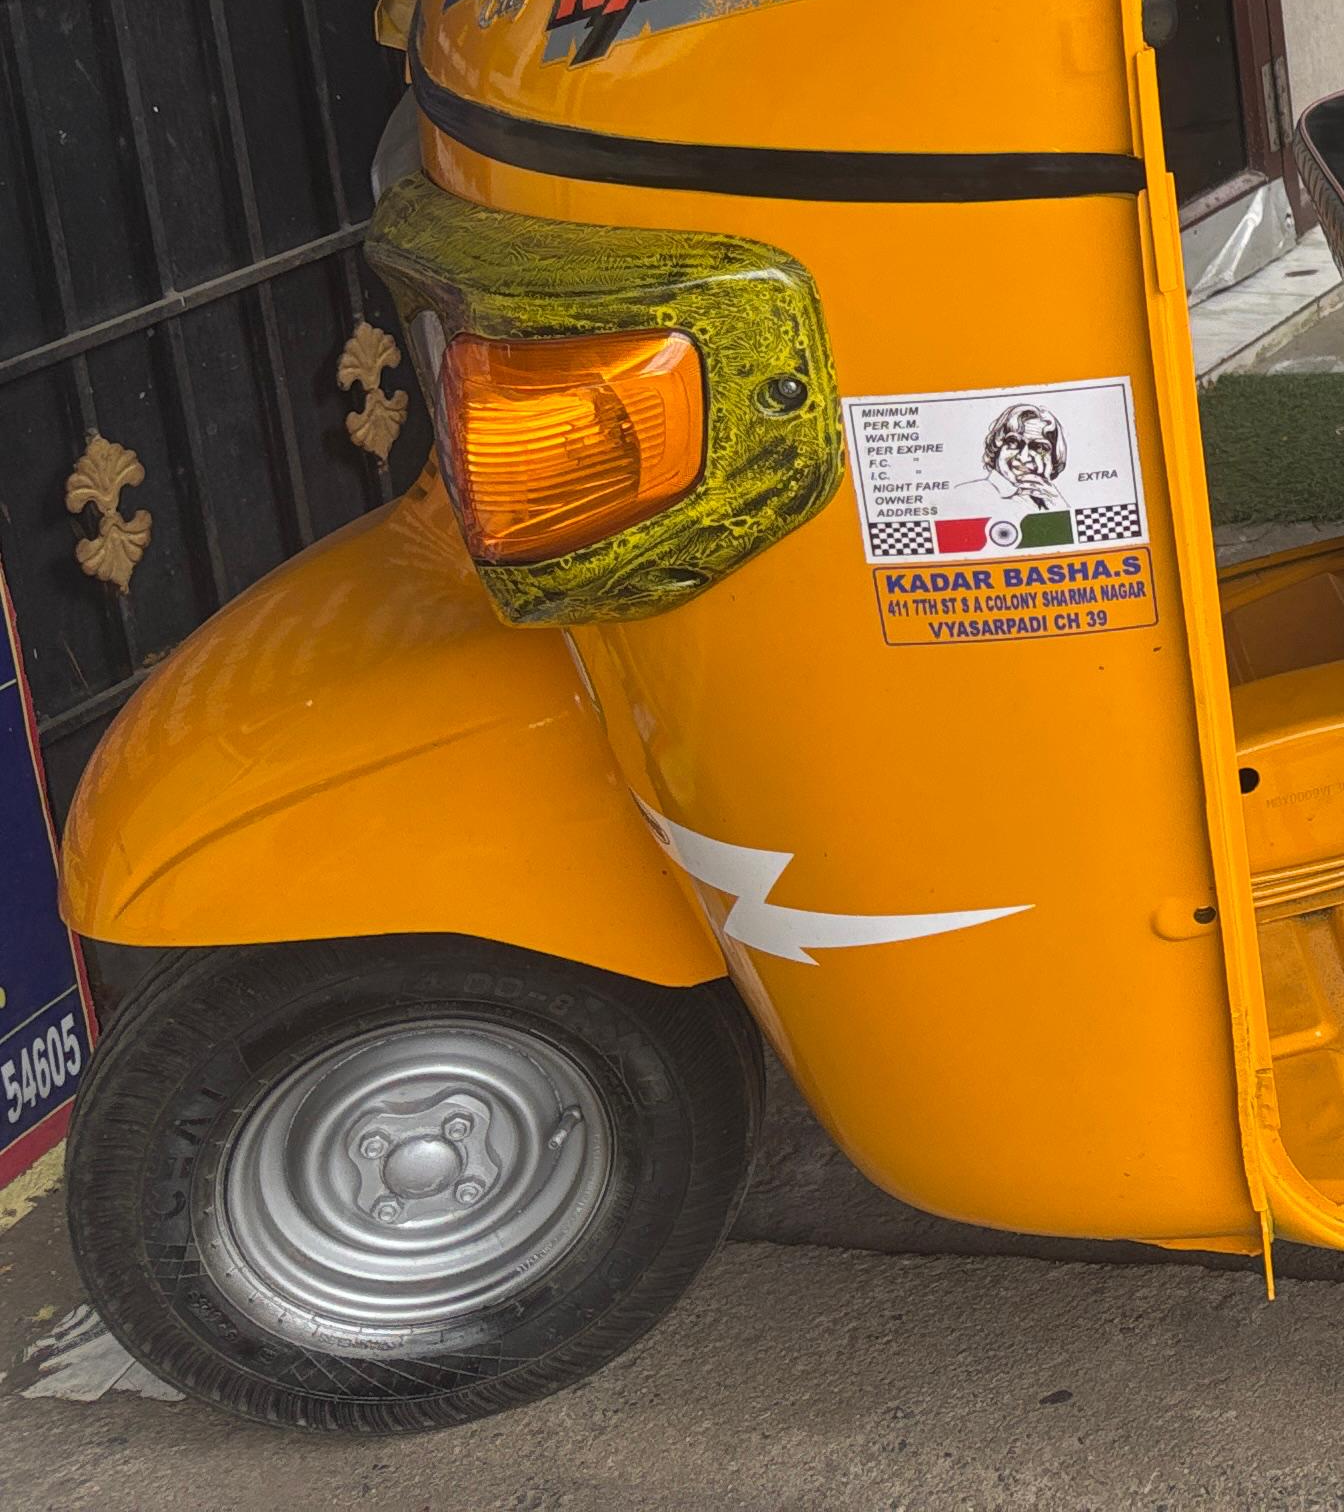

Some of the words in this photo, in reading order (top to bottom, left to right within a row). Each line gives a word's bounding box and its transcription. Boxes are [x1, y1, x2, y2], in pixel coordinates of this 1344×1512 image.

[862, 407, 919, 418] MINIMUM
[864, 421, 890, 431] PER
[893, 420, 920, 430] K.M.
[865, 432, 920, 443] WAITING
[867, 446, 893, 456] PER
[897, 443, 944, 455] EXPIRE
[873, 483, 912, 493] NIGHT
[915, 481, 950, 491] FARE
[1078, 470, 1118, 482] EXTRA
[875, 495, 923, 505] OWNER
[877, 506, 938, 518] ADDRESS
[887, 570, 995, 594] KADAR
[1003, 556, 1142, 588] BASHA.S
[888, 599, 910, 617] 411
[913, 597, 939, 616] 7TH
[942, 597, 957, 615] ST
[962, 597, 970, 614] S
[974, 596, 983, 613] A
[985, 592, 1038, 612] COLONY
[1042, 586, 1097, 607] SHARMA
[1100, 580, 1147, 600] NAGAR
[928, 615, 1048, 639] VYASARPADI
[1054, 612, 1081, 631] CH
[1086, 609, 1108, 627] 39
[1, 1013, 82, 1125] 54605
